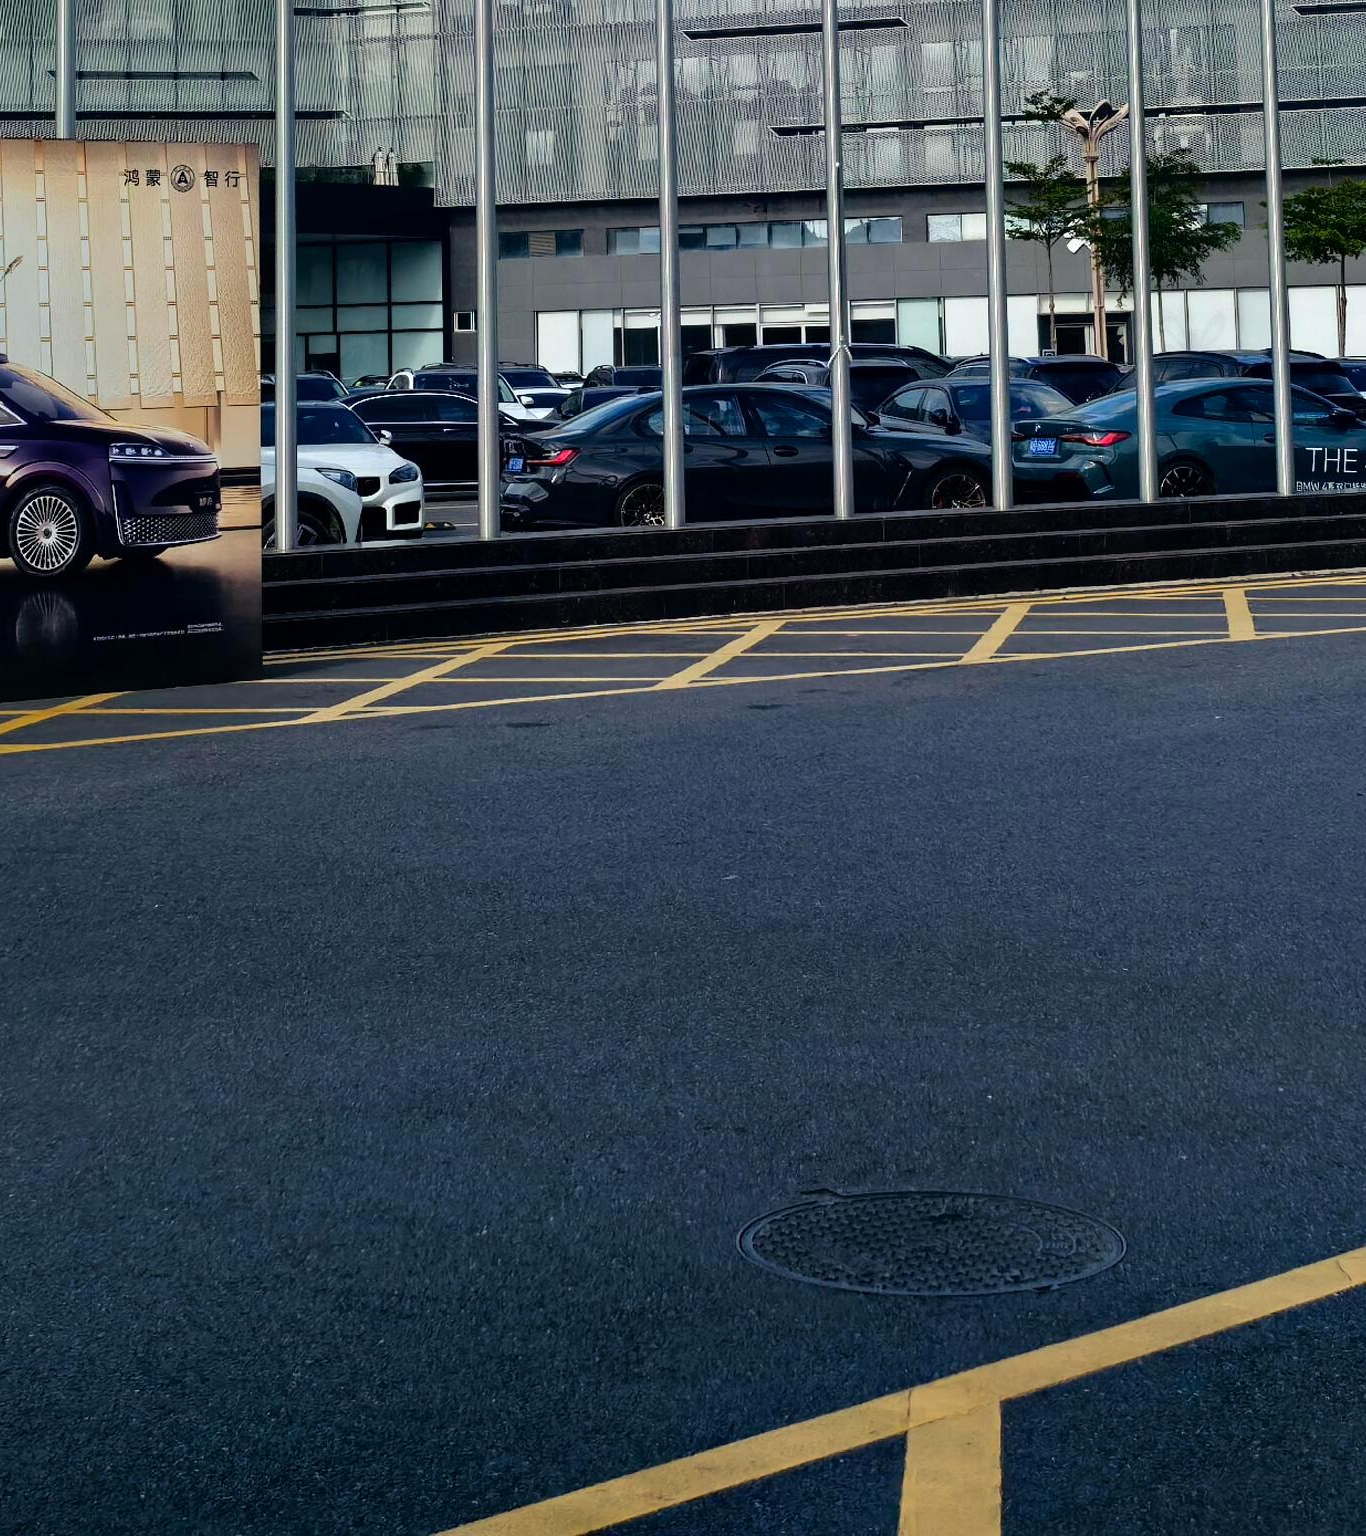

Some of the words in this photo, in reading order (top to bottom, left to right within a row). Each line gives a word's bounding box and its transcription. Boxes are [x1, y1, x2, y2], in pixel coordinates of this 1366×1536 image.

[123, 168, 161, 187] 鸿蒙
[203, 170, 241, 188] 智行
[1305, 447, 1358, 473] THE
